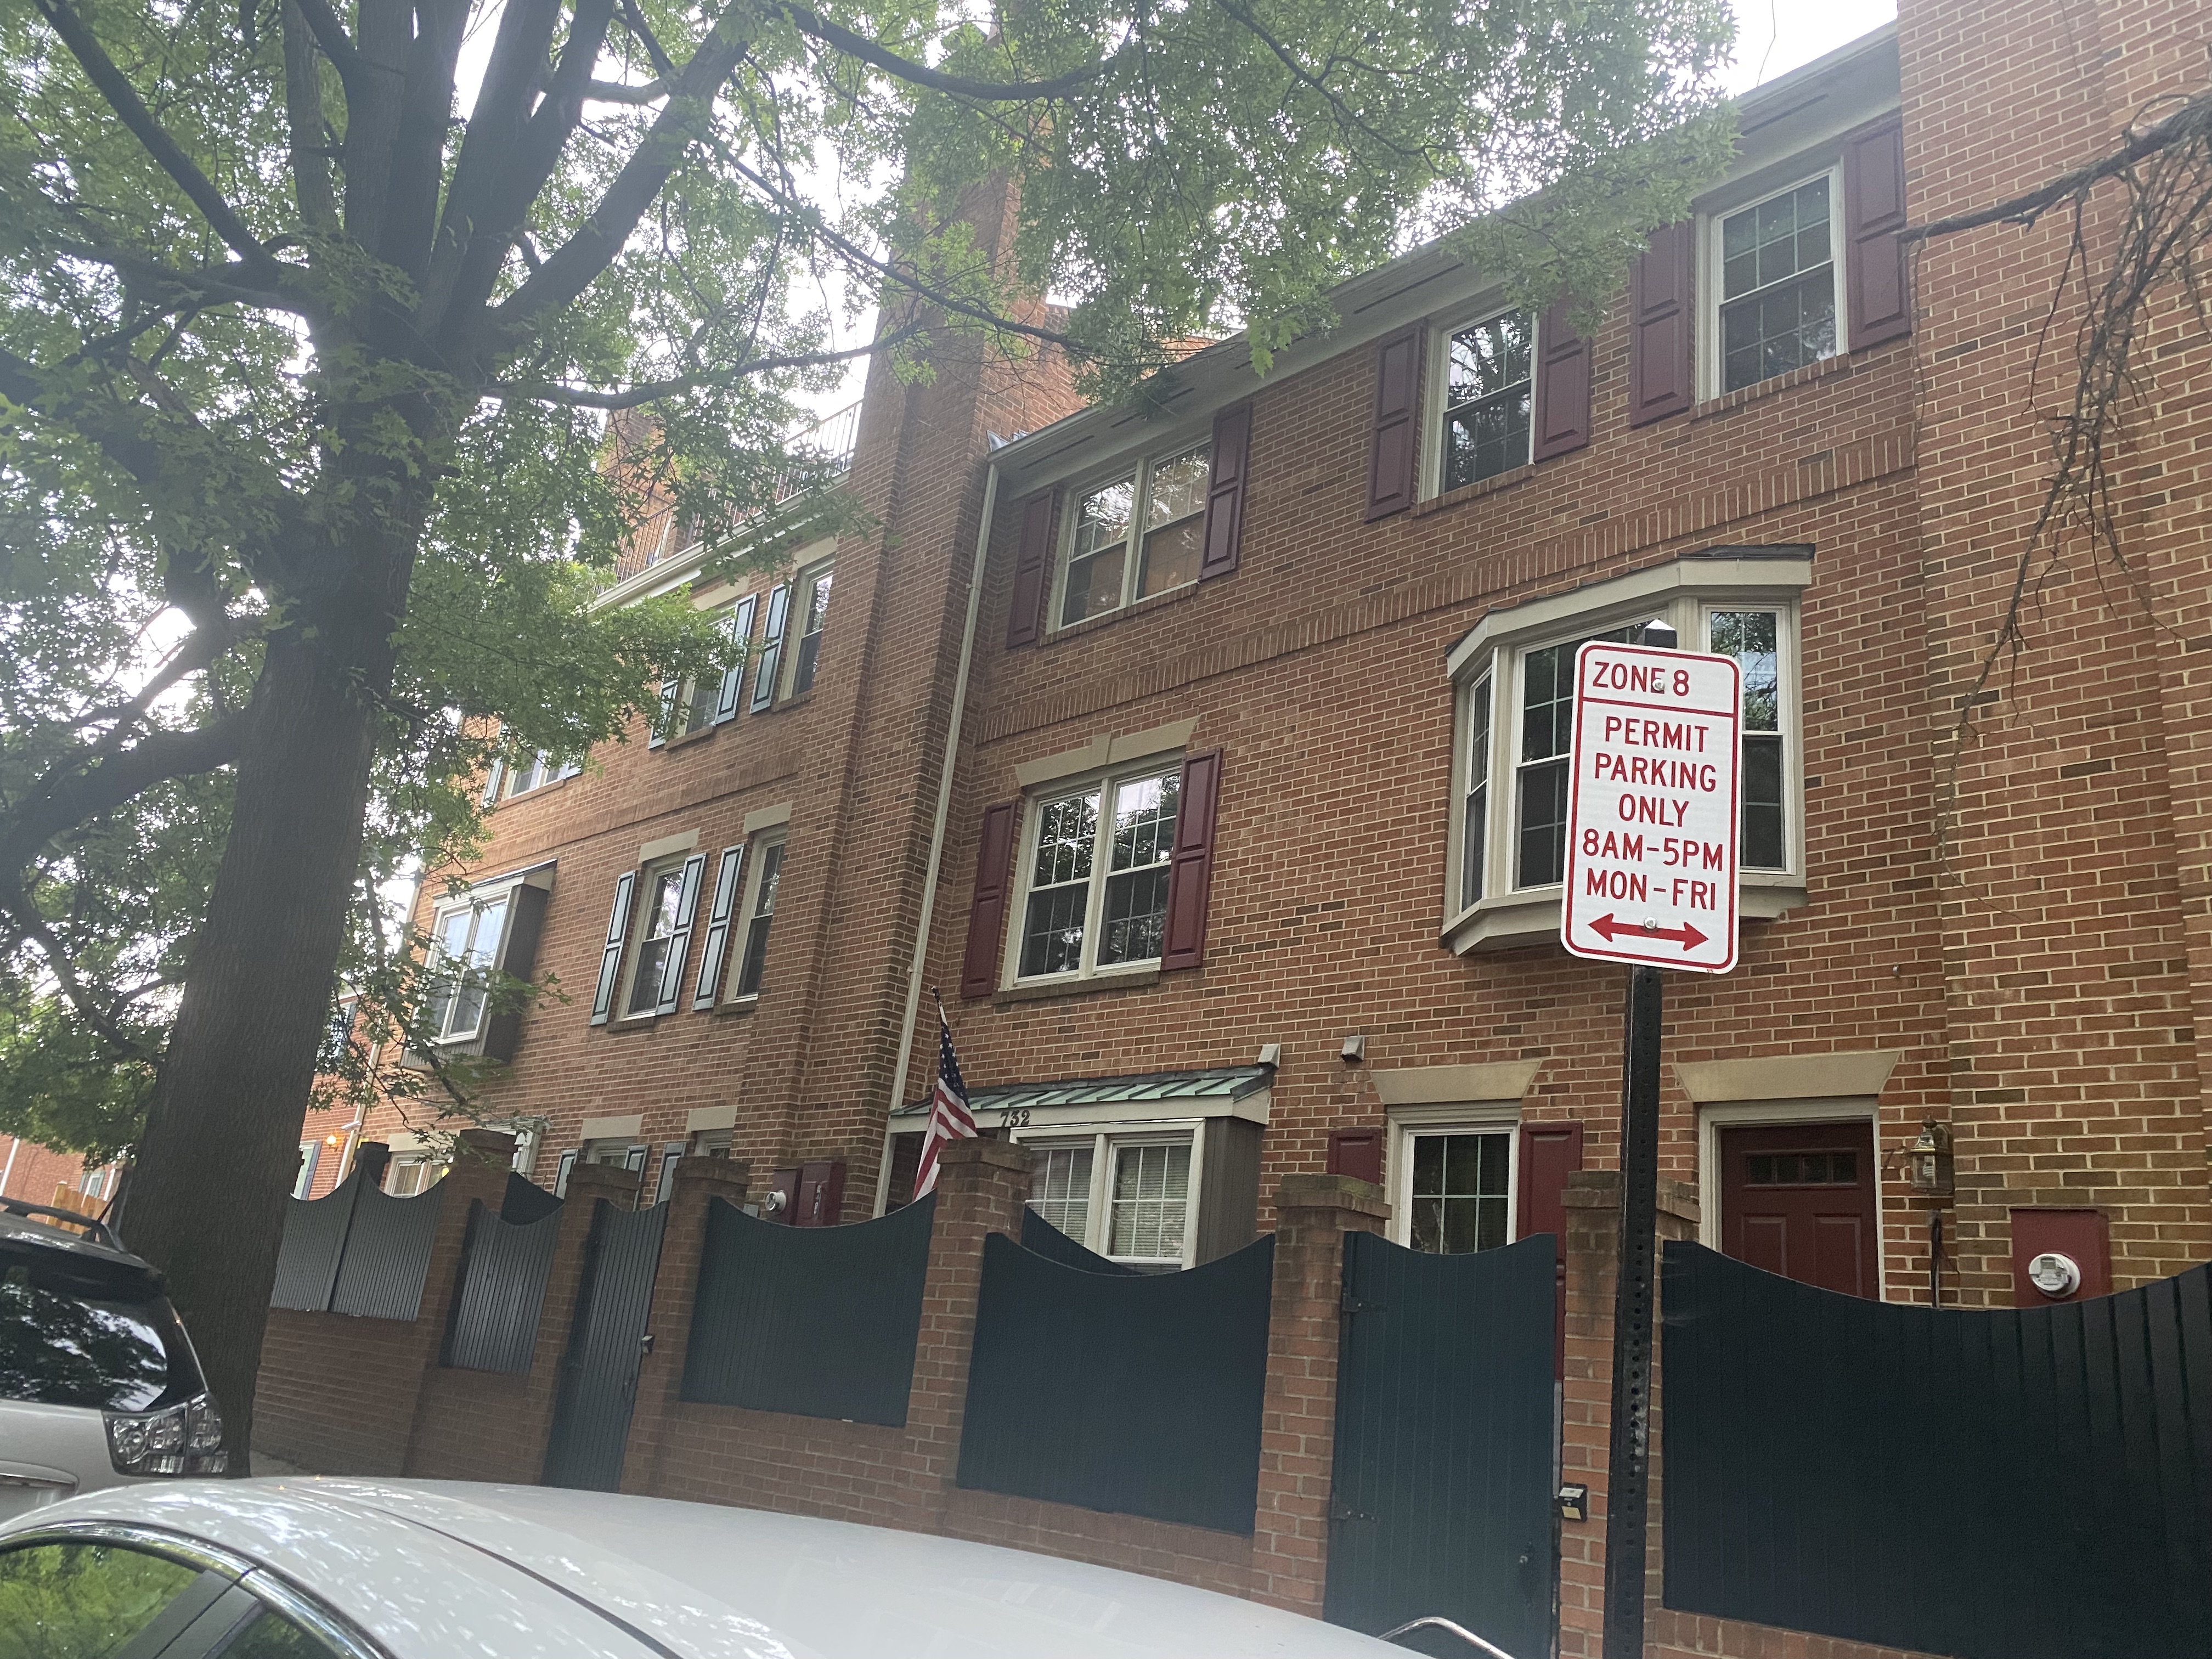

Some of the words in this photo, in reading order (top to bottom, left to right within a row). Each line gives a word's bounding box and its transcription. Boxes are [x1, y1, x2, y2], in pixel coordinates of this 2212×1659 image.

[1593, 662, 1665, 694] ZONE
[1673, 669, 1689, 696] 8
[1605, 716, 1708, 752] PERMIT
[1595, 753, 1716, 792] PARKING
[1618, 793, 1689, 827] ONLY
[1583, 828, 1723, 871] 8AM-5PM
[1000, 1110, 1030, 1128] 732
